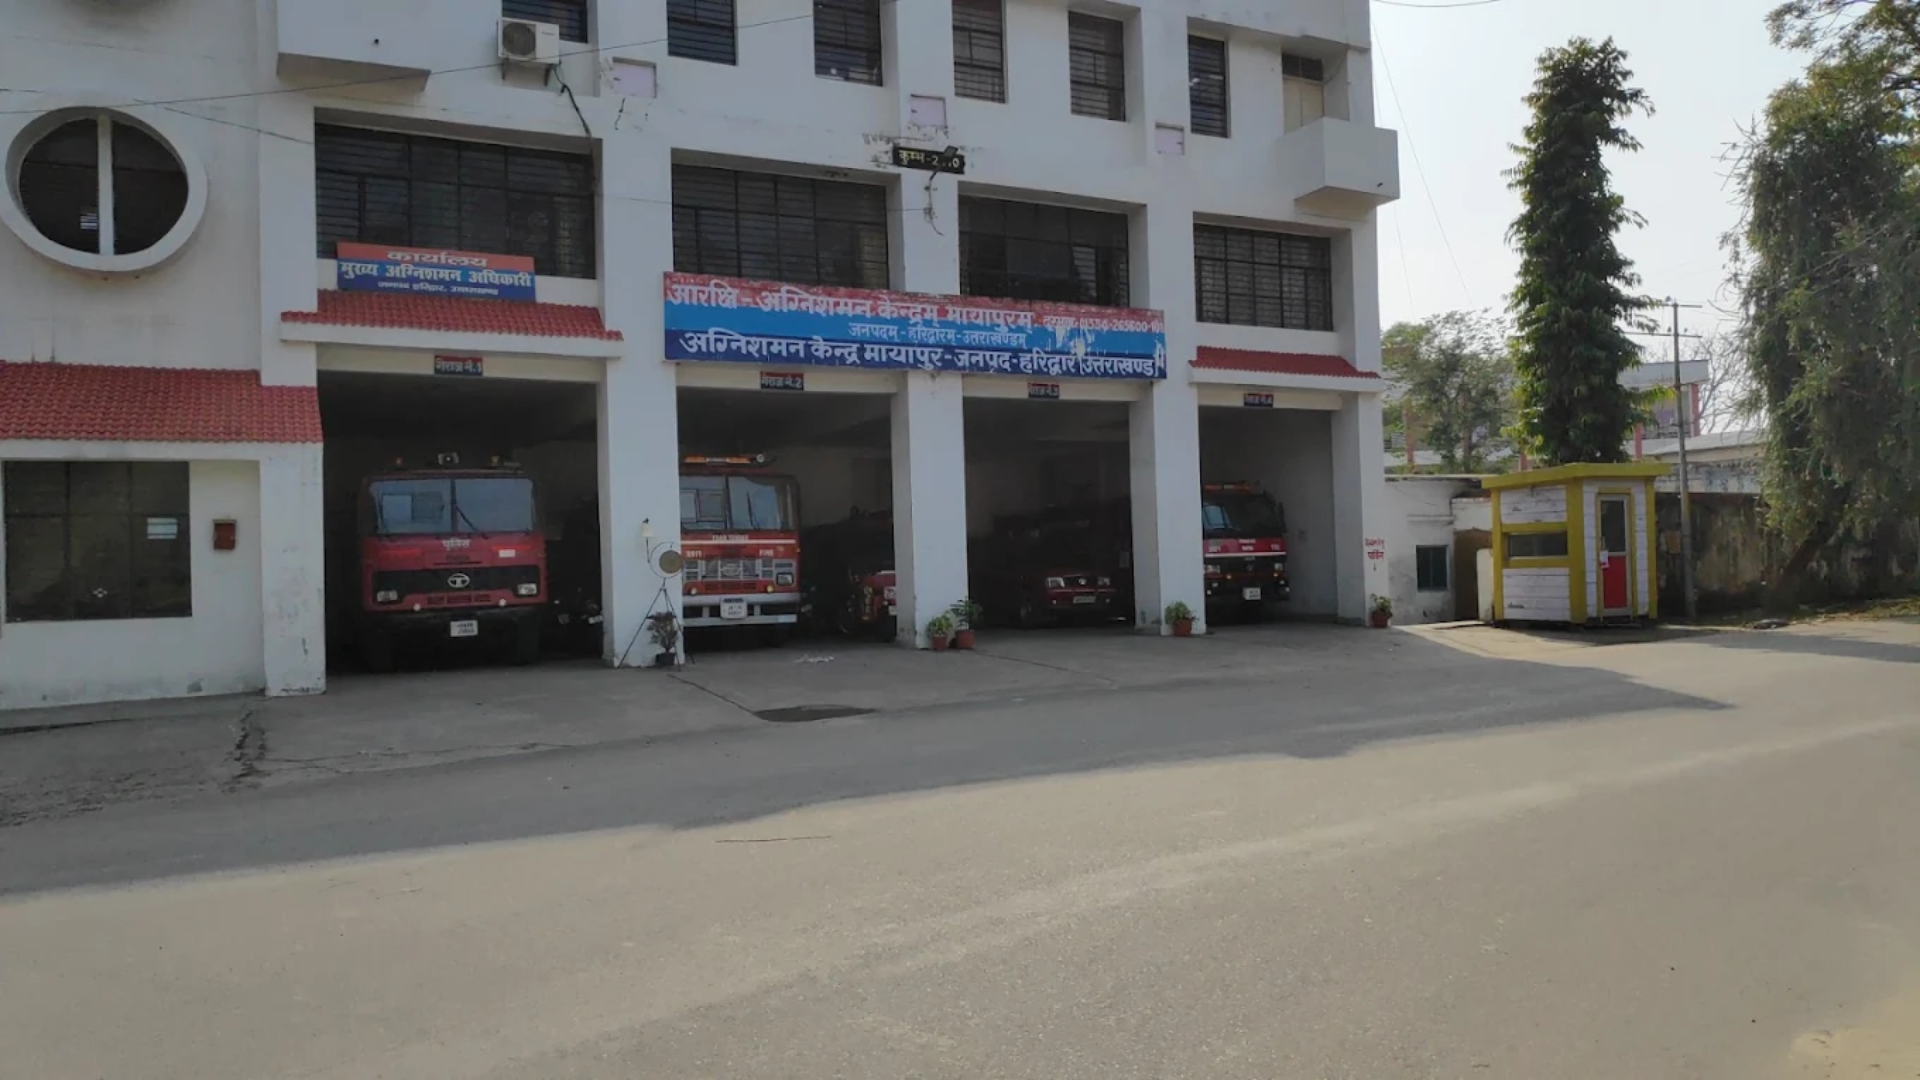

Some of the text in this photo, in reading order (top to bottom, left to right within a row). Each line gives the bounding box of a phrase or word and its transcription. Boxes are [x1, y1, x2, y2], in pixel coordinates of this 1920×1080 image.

[387, 250, 489, 267] कार्यालय
[340, 262, 532, 287] मुख्य अग्निशमन अधिकारी
[757, 286, 871, 317] अग्निशमन
[946, 305, 1035, 333] मायापुरम्
[678, 327, 806, 357] अग्निशमन
[810, 335, 861, 364] केन्द्र
